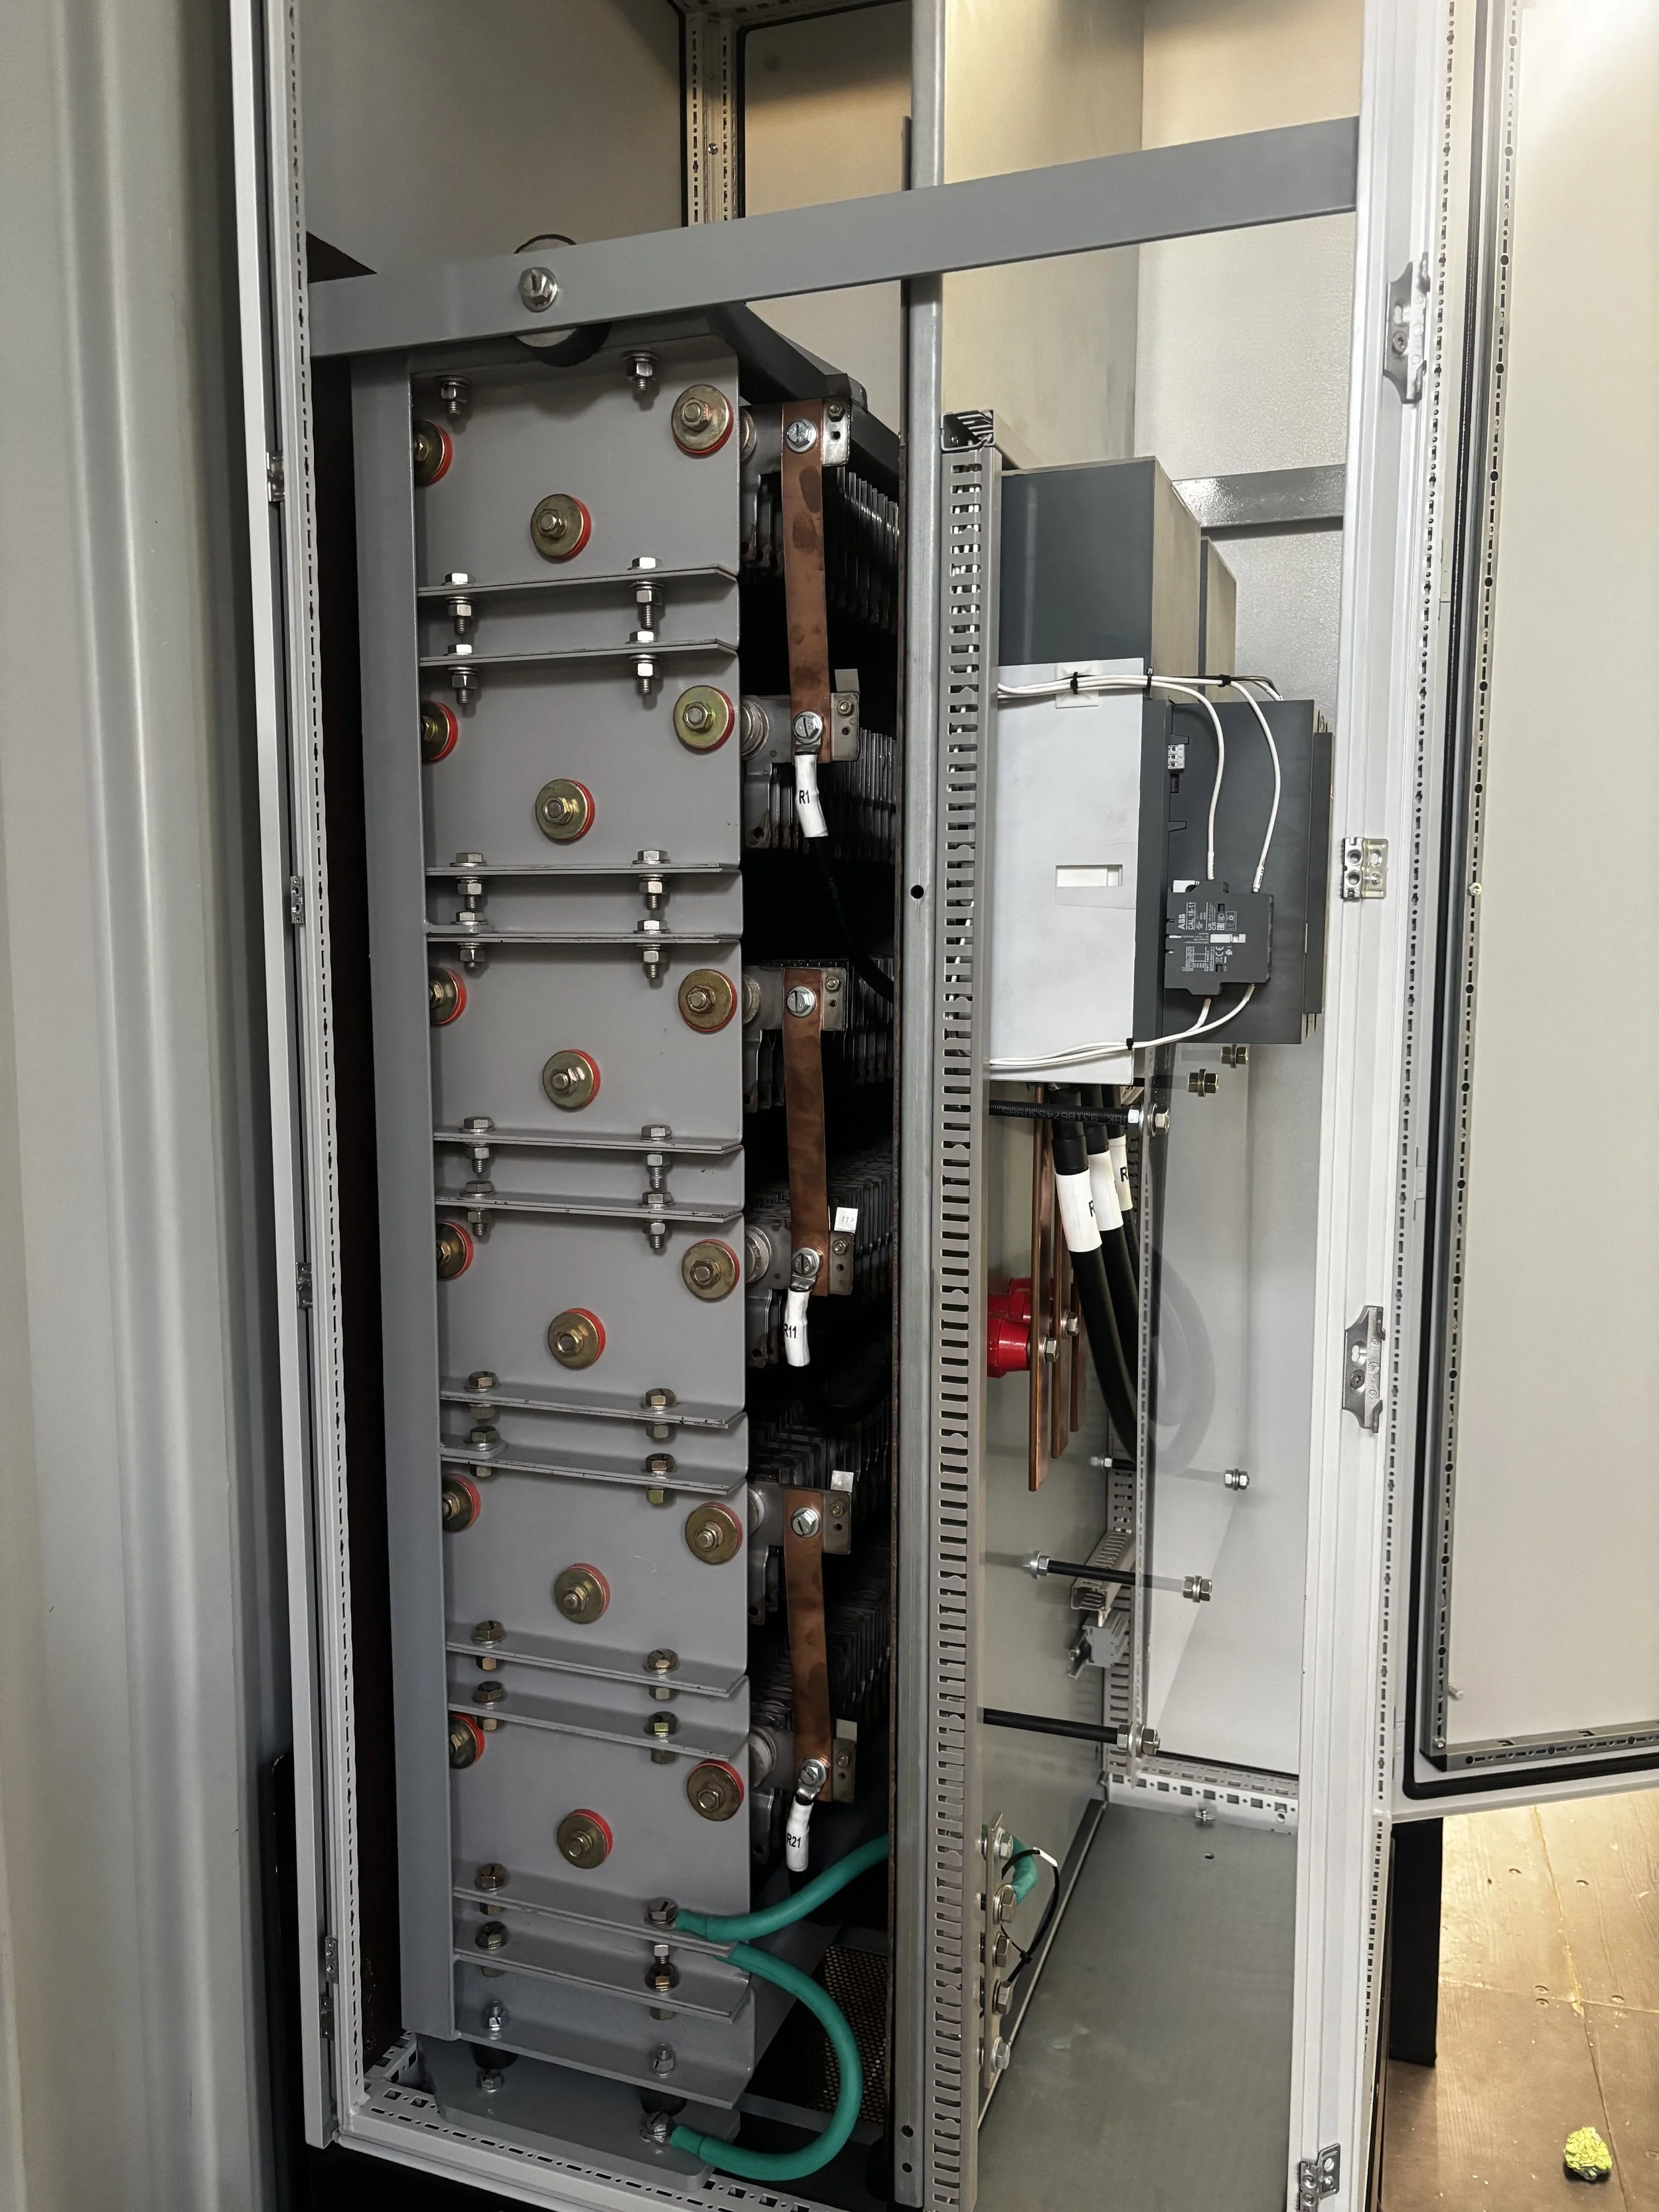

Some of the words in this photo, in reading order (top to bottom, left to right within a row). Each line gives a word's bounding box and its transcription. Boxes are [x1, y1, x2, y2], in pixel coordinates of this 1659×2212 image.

[799, 790, 810, 804] R1
[784, 1323, 796, 1339] R11
[786, 1832, 801, 1848] R21
